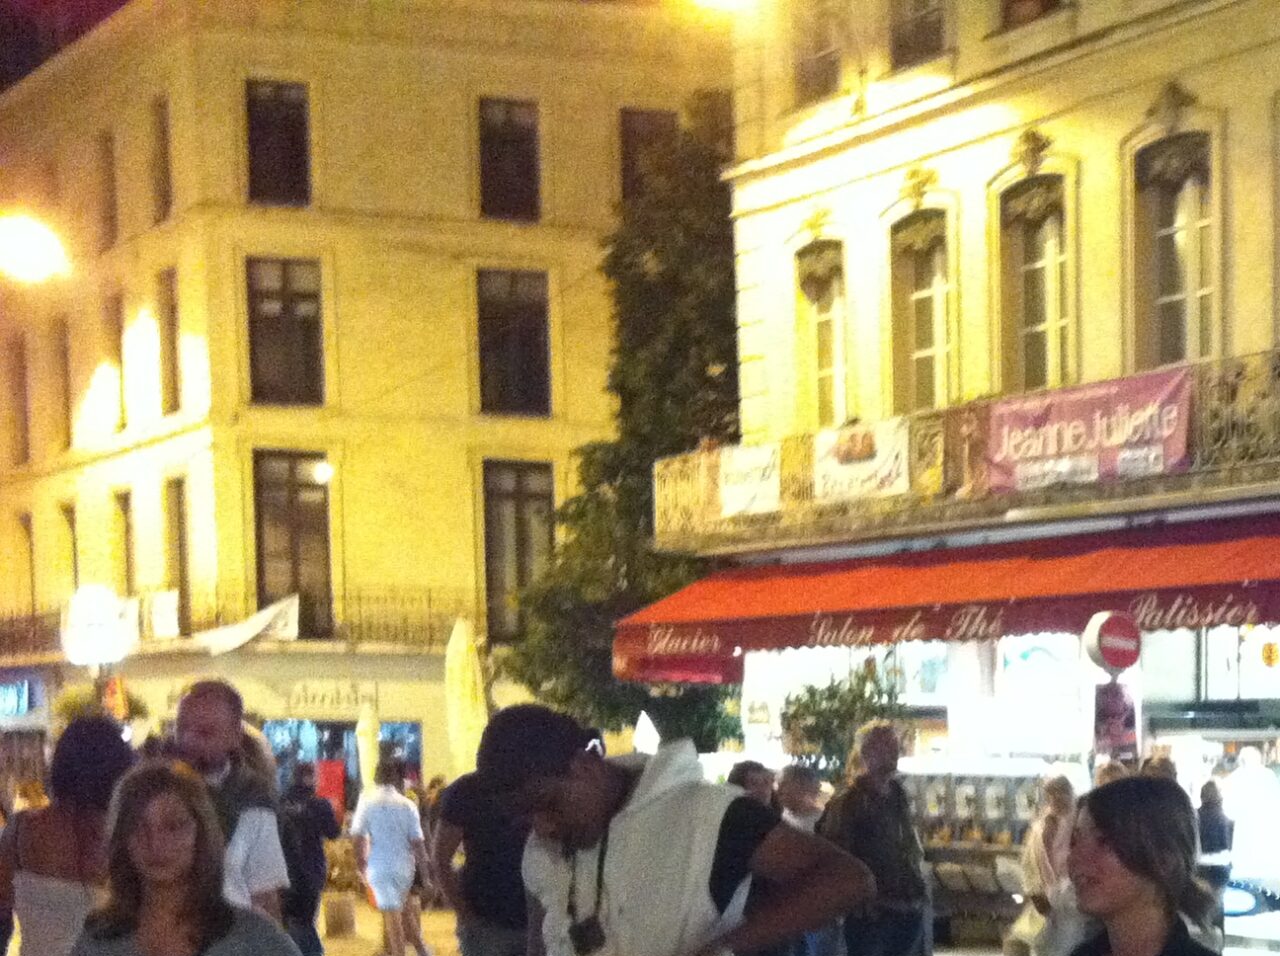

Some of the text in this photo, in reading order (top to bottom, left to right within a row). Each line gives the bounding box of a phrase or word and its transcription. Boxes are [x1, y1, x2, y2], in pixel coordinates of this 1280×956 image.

[993, 419, 1087, 464] Jeanne
[646, 622, 721, 656] Glacier
[892, 610, 926, 642] de
